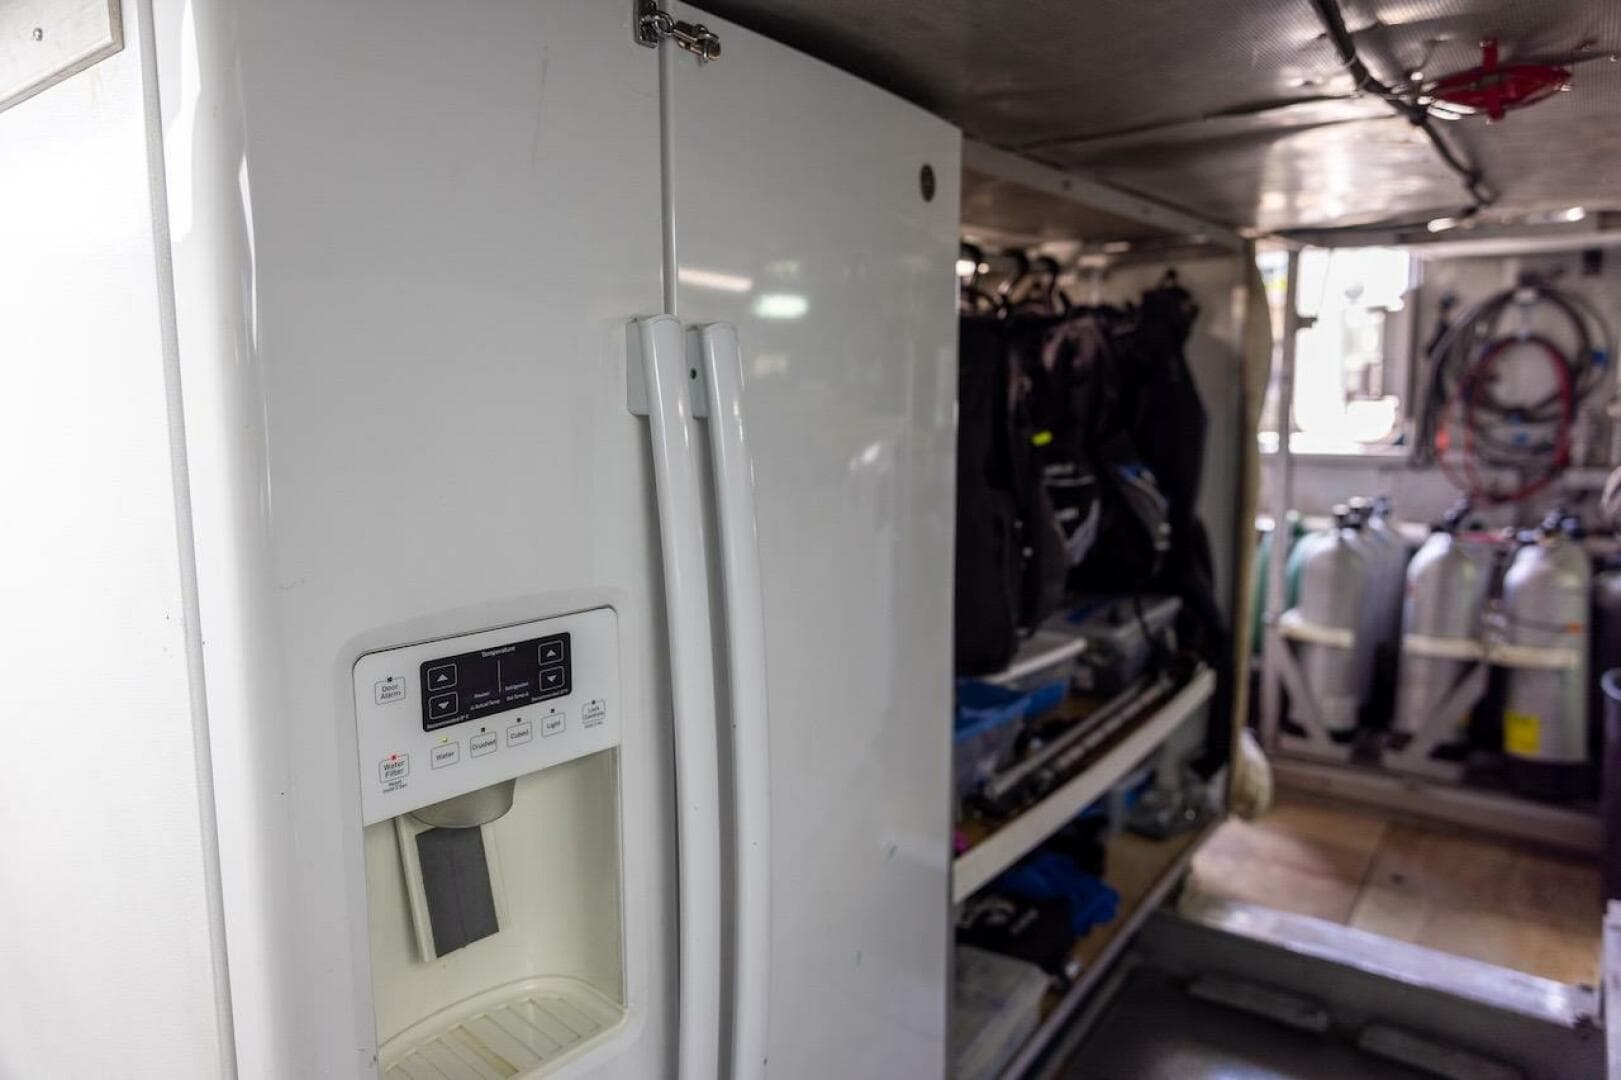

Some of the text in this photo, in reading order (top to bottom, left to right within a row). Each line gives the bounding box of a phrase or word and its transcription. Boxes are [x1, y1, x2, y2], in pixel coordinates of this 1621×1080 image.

[381, 683, 399, 692] Door
[380, 690, 401, 700] Alarm
[510, 729, 529, 739] Cubed
[436, 750, 455, 760] Water
[383, 760, 405, 771] Water
[384, 768, 404, 778] Filter
